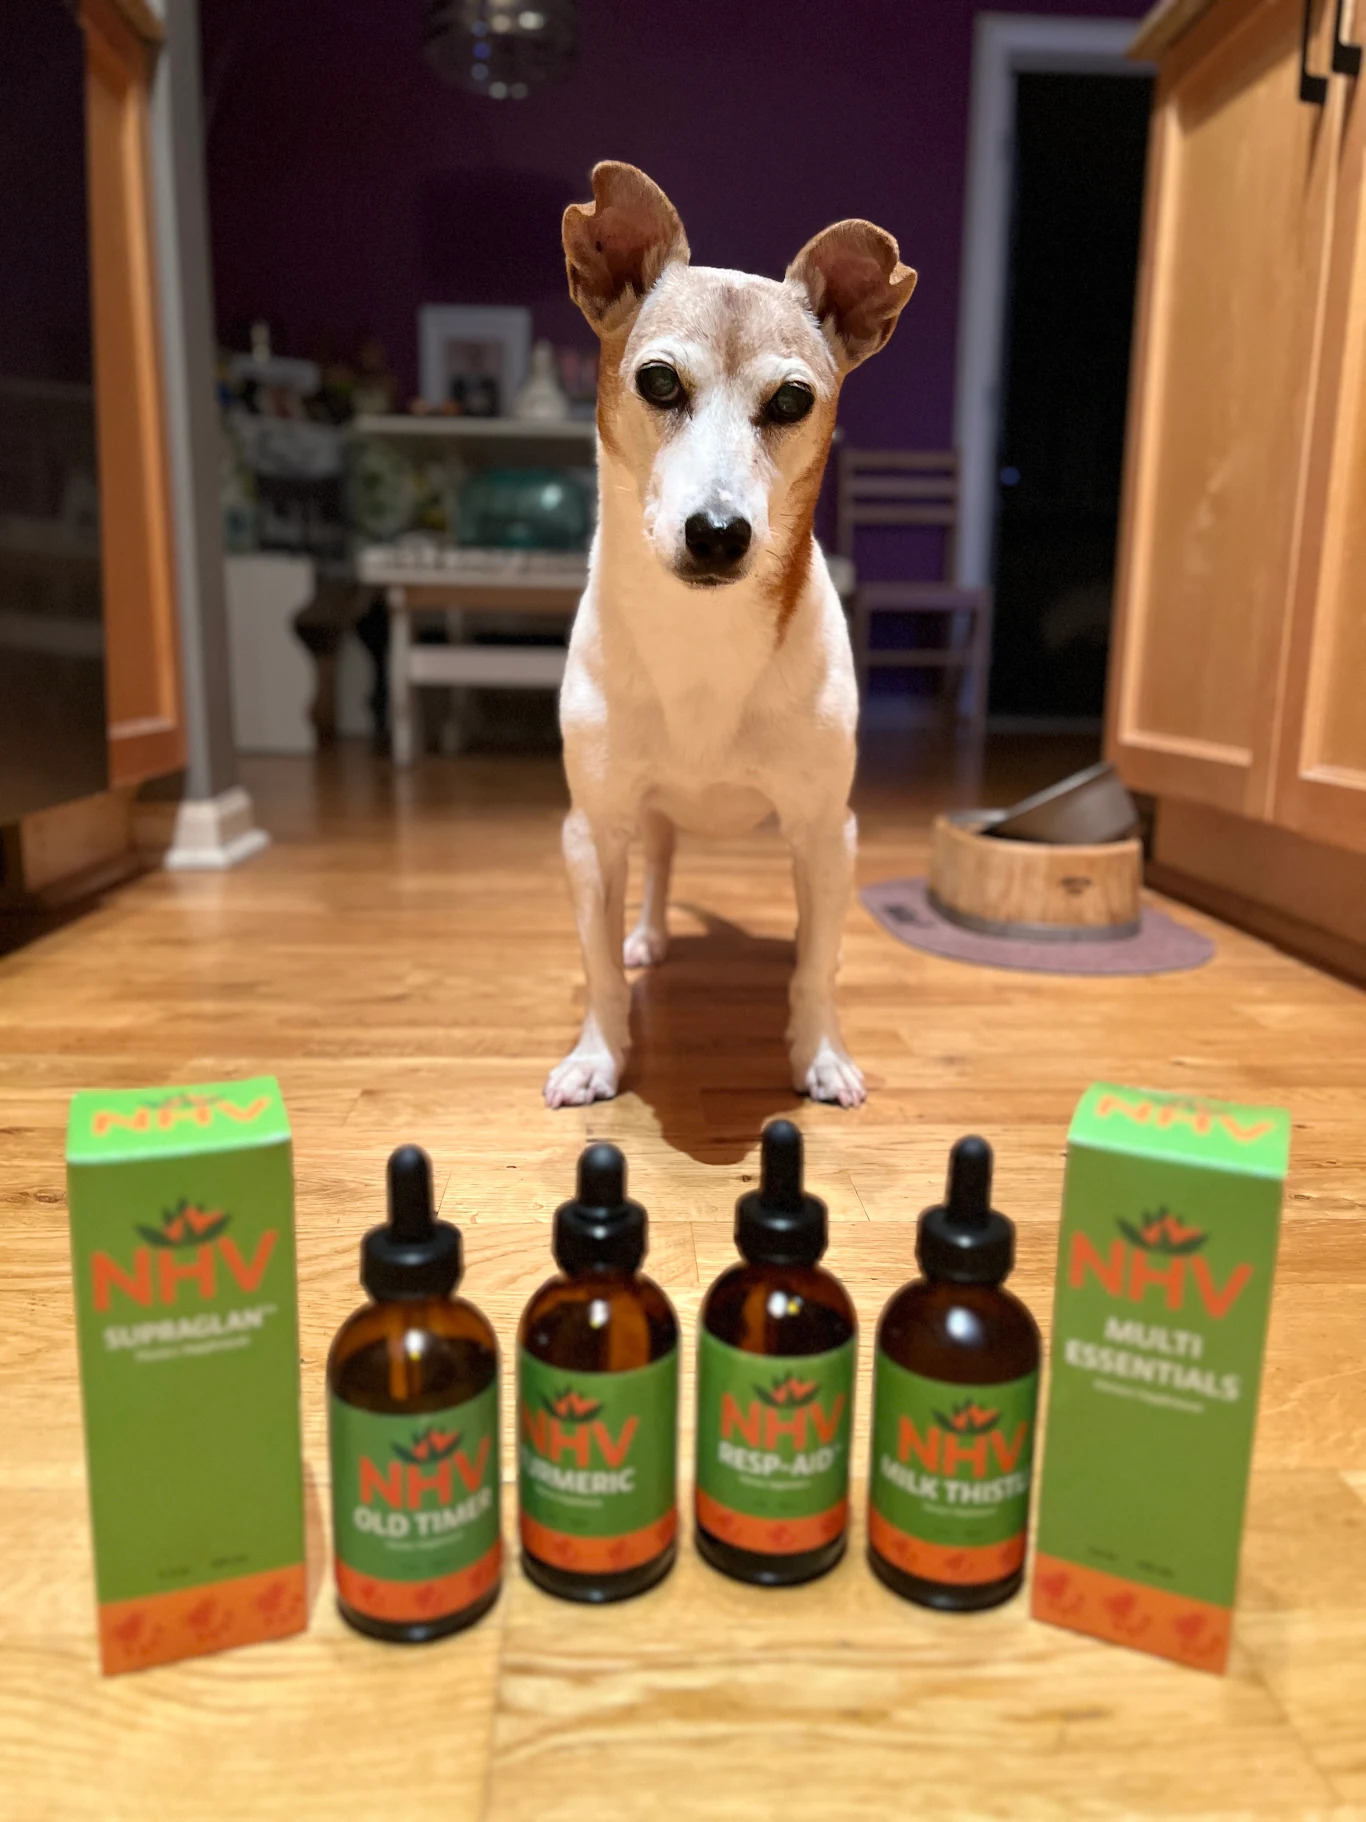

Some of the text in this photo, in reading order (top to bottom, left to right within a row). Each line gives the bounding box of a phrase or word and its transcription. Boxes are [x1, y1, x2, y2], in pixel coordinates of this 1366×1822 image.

[92, 1095, 272, 1138] NHV
[1094, 1093, 1276, 1143] NHV
[91, 1228, 279, 1313] NHV
[1067, 1230, 1254, 1321] NHV
[1104, 1315, 1205, 1360] MULTI
[1063, 1337, 1242, 1403] ESSENTIALS
[520, 1400, 640, 1470] NHV
[720, 1391, 847, 1452] NHV
[898, 1414, 1029, 1480] NHV
[358, 1436, 491, 1511] NHV
[880, 1453, 939, 1500] MILK
[353, 1504, 410, 1538] OLD
[414, 1486, 493, 1536] TIMER
